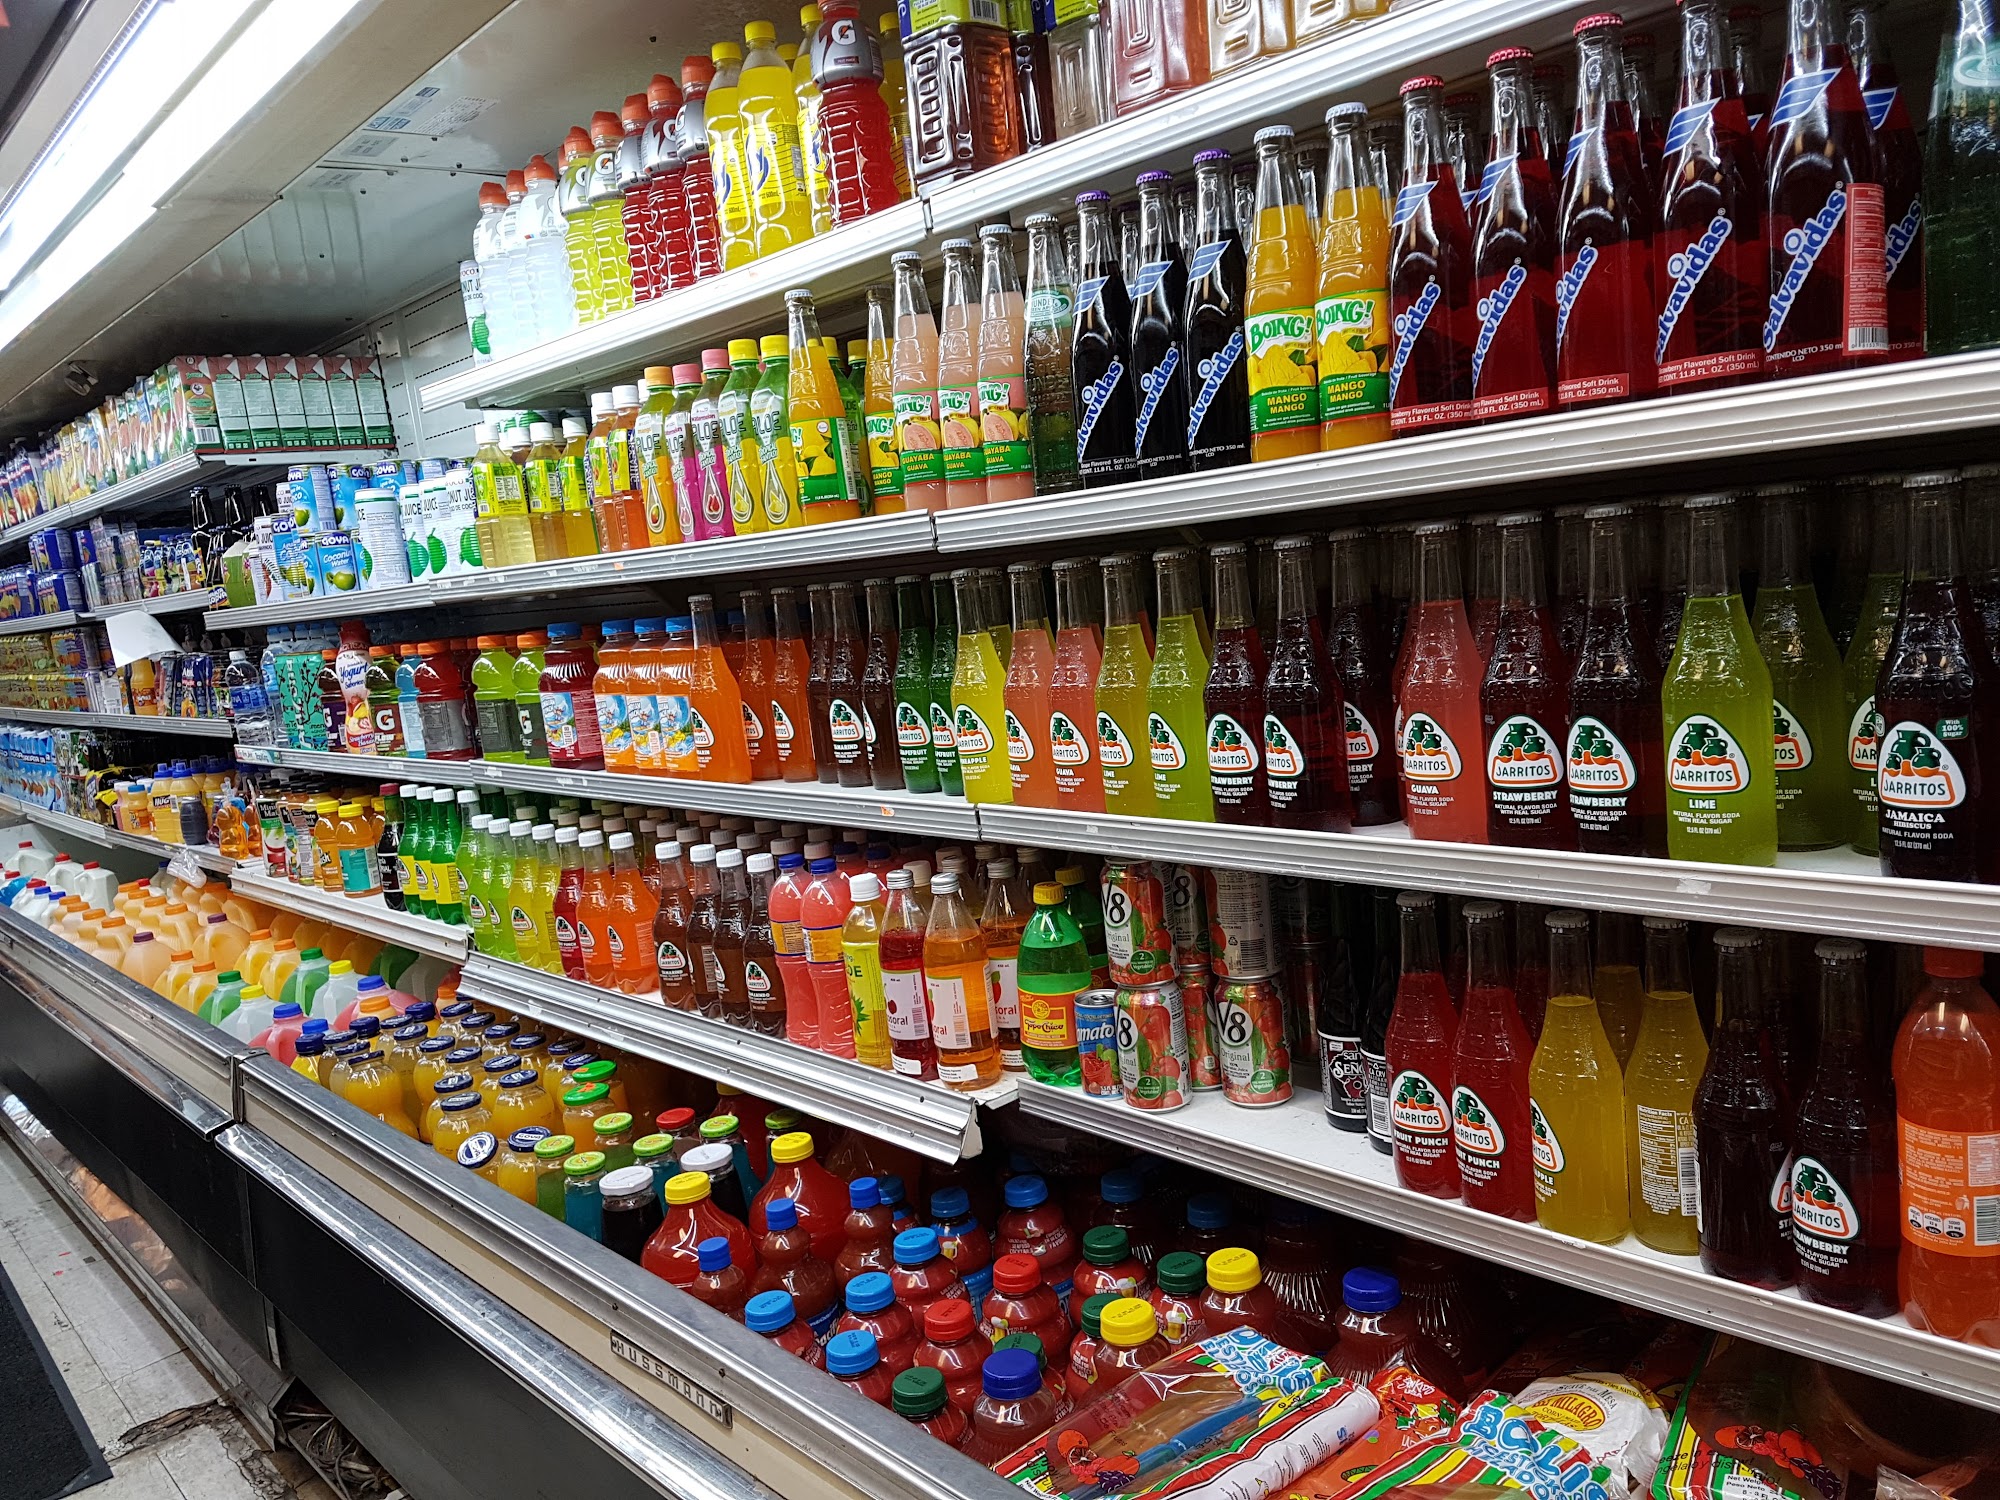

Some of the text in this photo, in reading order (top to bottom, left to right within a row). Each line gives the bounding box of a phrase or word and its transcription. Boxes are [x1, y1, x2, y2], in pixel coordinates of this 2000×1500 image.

[831, 20, 857, 45] G
[594, 152, 614, 175] G
[1763, 188, 1848, 353] Salvavidas
[1315, 298, 1374, 341] BOING!
[1249, 315, 1314, 354] BOING!
[1797, 346, 1818, 356] NETO
[1684, 351, 1757, 369] Flavored Soft Drink
[1679, 369, 1696, 379] 11.8
[1726, 362, 1745, 372] (350
[1327, 379, 1366, 394] MANGO
[1582, 377, 1620, 388] Soft Drink
[1330, 390, 1364, 403] MANGO
[1504, 394, 1518, 403] Soft
[1519, 392, 1540, 401] Drink
[1589, 387, 1607, 396] (350
[1267, 392, 1307, 406] MANGO
[1511, 401, 1527, 410] (350
[1528, 399, 1545, 408] mL)
[1270, 403, 1305, 414] MANGO
[1412, 404, 1455, 416] Flavored Soft
[692, 420, 719, 442] ALOE
[907, 461, 928, 471] GUAVA
[321, 535, 350, 545] GOYA
[339, 662, 368, 683] Yogurt
[377, 709, 395, 731] G
[1945, 718, 1960, 726] With
[833, 727, 856, 736] ARRITOS
[1942, 724, 1964, 732] 100%
[1942, 730, 1962, 738] Sugar
[898, 732, 922, 741] ARRITOS
[1349, 763, 1374, 773] BERRY
[1406, 760, 1447, 772] JARRITOS
[1495, 764, 1550, 777] JARRITOS
[1570, 768, 1619, 781] JARRITOS
[1674, 769, 1734, 784] JARRITOS
[1411, 783, 1439, 795] GUAVA
[1883, 780, 1946, 797] JARRITOS
[1492, 789, 1558, 802] STRAWBERRY
[1517, 803, 1540, 811] FLAVOR
[1541, 802, 1558, 810] SODA
[1688, 798, 1717, 810] LIME
[1598, 814, 1620, 822] SUGAR
[1885, 809, 1946, 824] JAMAICA
[1894, 820, 1932, 830] HIBISCUS
[1904, 830, 1930, 839] FLAVOR
[1101, 879, 1126, 924] V8
[1216, 998, 1247, 1043] V8
[1221, 1047, 1251, 1062] Original
[1395, 1111, 1439, 1126] JARRITOS
[1656, 1109, 1673, 1117] Facts
[518, 1132, 542, 1141] GOYA
[1393, 1130, 1449, 1147] FRUIT PUNCH
[1468, 1154, 1500, 1169] PUNCH
[1793, 1205, 1841, 1229] JARRITOS
[1818, 1258, 1840, 1268] SUGAR
[1829, 1255, 1849, 1264] SODA
[614, 1338, 719, 1418] HUSSMANN
[1550, 1395, 1602, 1428] MILAGRO
[1747, 1483, 1766, 1492] Neto
